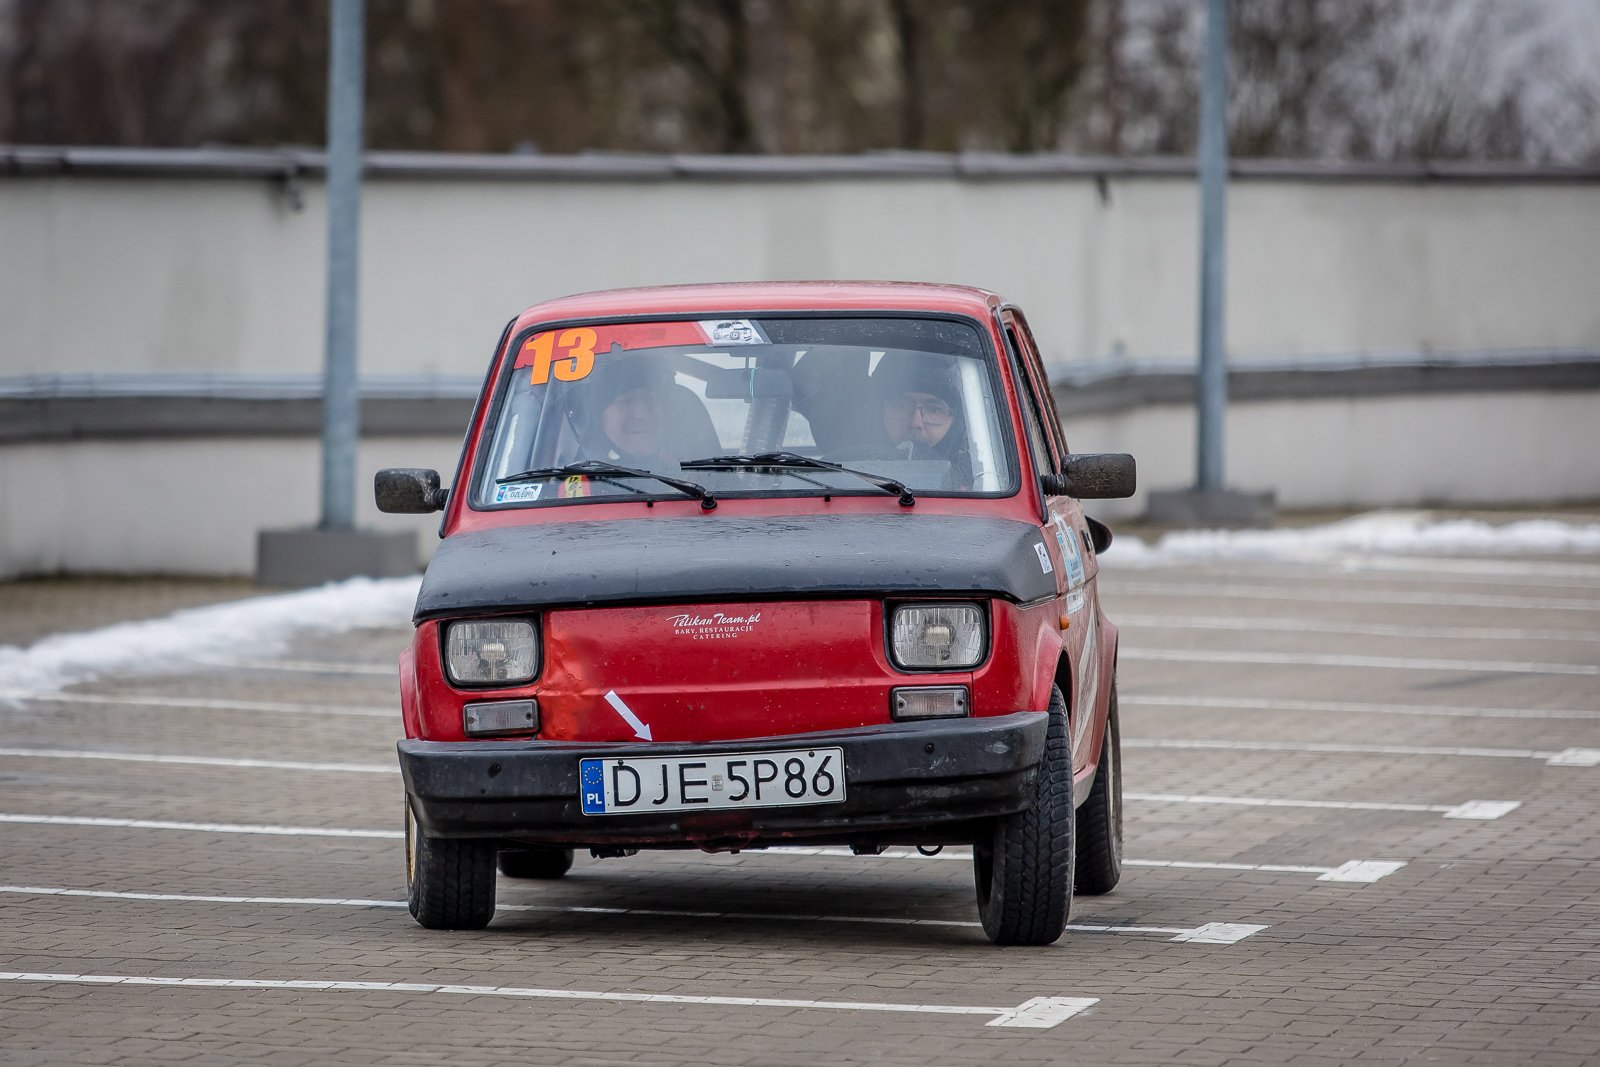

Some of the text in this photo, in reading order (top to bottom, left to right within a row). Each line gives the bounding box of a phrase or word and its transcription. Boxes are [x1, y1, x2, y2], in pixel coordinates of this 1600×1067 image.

[526, 328, 598, 385] 13
[693, 632, 738, 640] CATERING
[612, 755, 836, 807] DJE 5P86
[587, 793, 603, 805] PL
